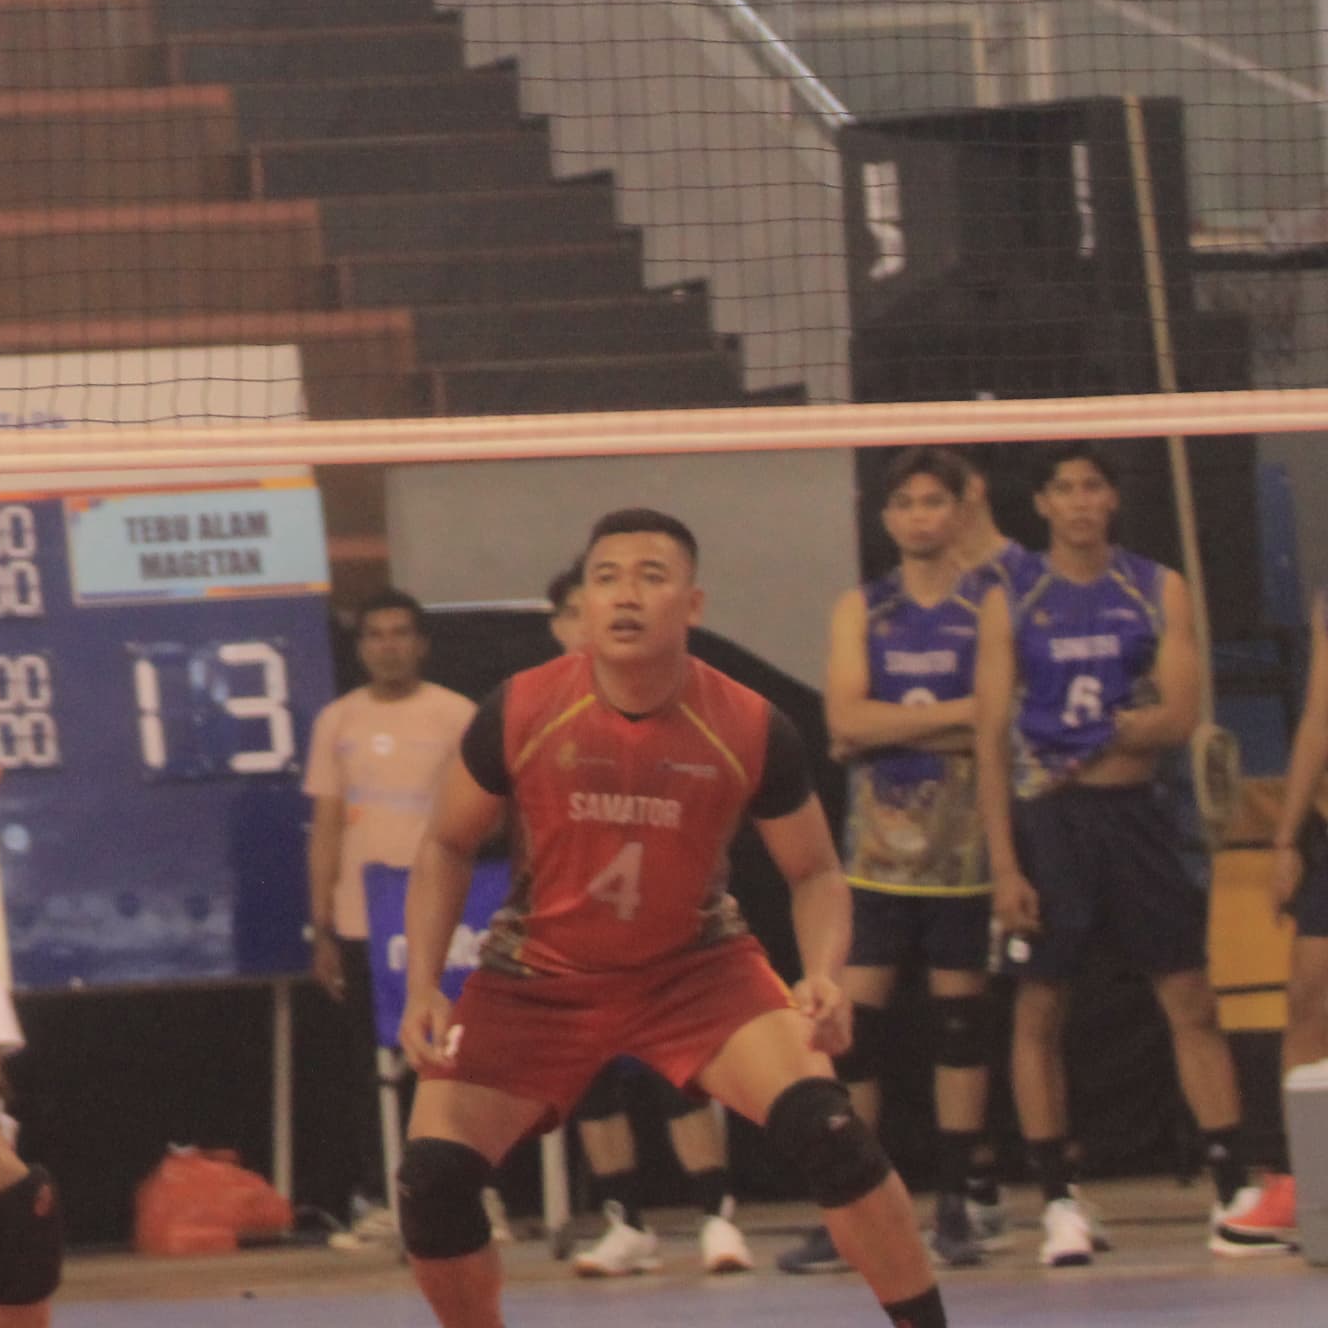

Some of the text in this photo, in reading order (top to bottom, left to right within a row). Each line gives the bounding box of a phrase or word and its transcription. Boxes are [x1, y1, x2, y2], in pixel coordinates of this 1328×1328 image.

[124, 511, 270, 544] TEBU ALAM
[140, 548, 263, 579] MAGETAN
[568, 791, 683, 830] SAMATOR
[589, 841, 644, 921] 4
